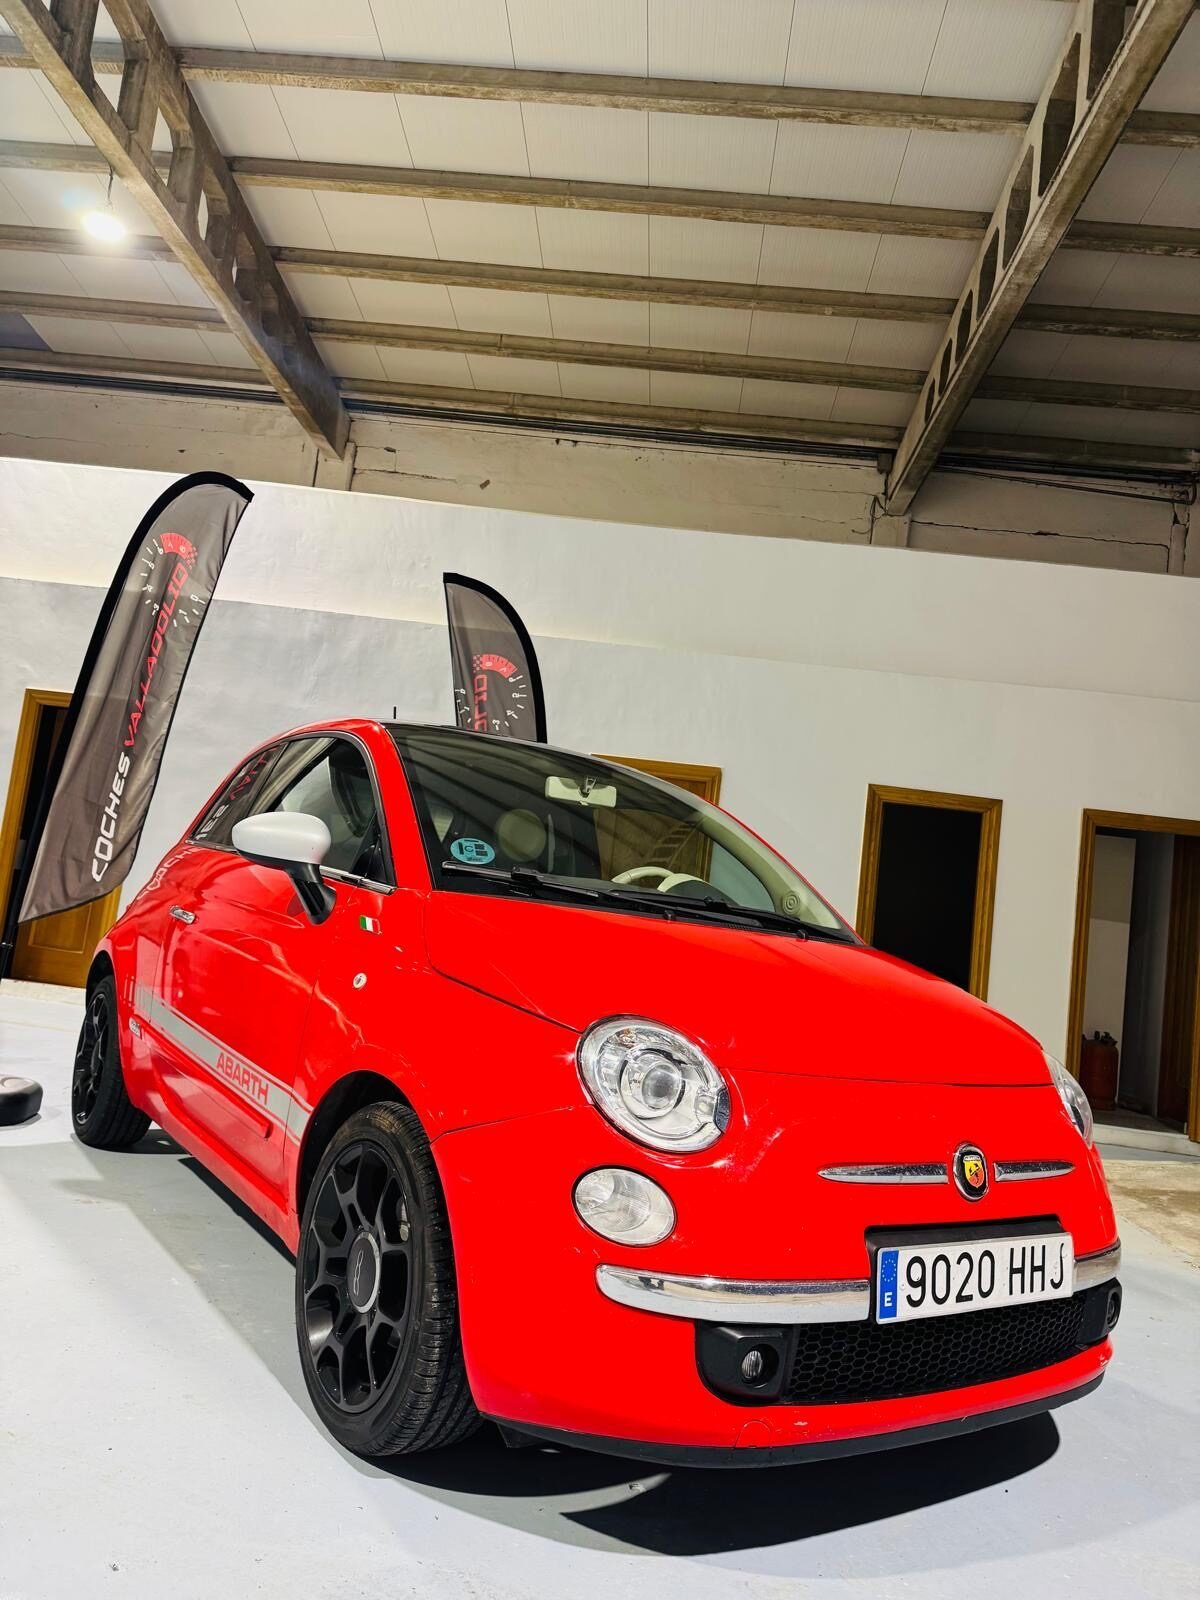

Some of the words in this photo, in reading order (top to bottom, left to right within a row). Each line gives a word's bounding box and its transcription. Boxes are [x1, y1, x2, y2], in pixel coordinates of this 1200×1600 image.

[91, 751, 131, 882] COCHES
[124, 562, 189, 747] VALLADOLID
[216, 1052, 269, 1105] ABARTH
[884, 1291, 893, 1307] E
[905, 1249, 996, 1308] 9020
[1008, 1243, 1066, 1296] HHJ
